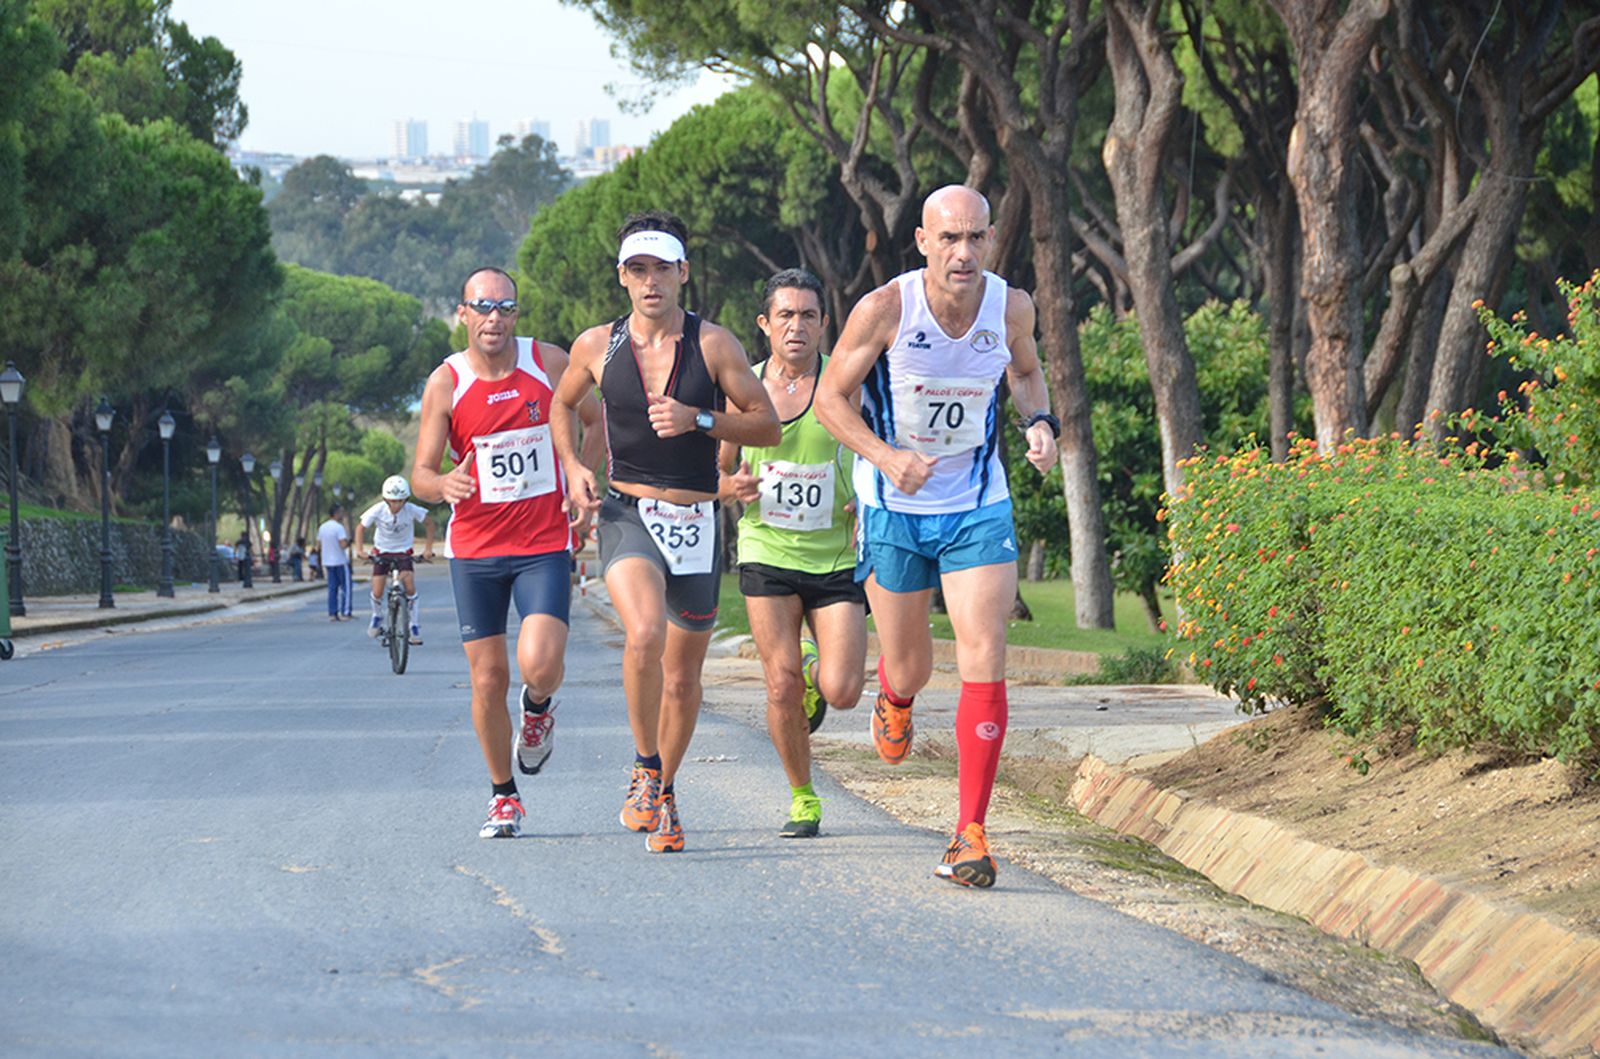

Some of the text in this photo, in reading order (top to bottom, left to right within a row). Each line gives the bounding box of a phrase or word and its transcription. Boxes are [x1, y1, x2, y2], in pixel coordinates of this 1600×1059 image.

[928, 402, 965, 429] 70
[491, 448, 539, 478] 501
[772, 481, 821, 508] 130
[650, 522, 700, 549] 353
